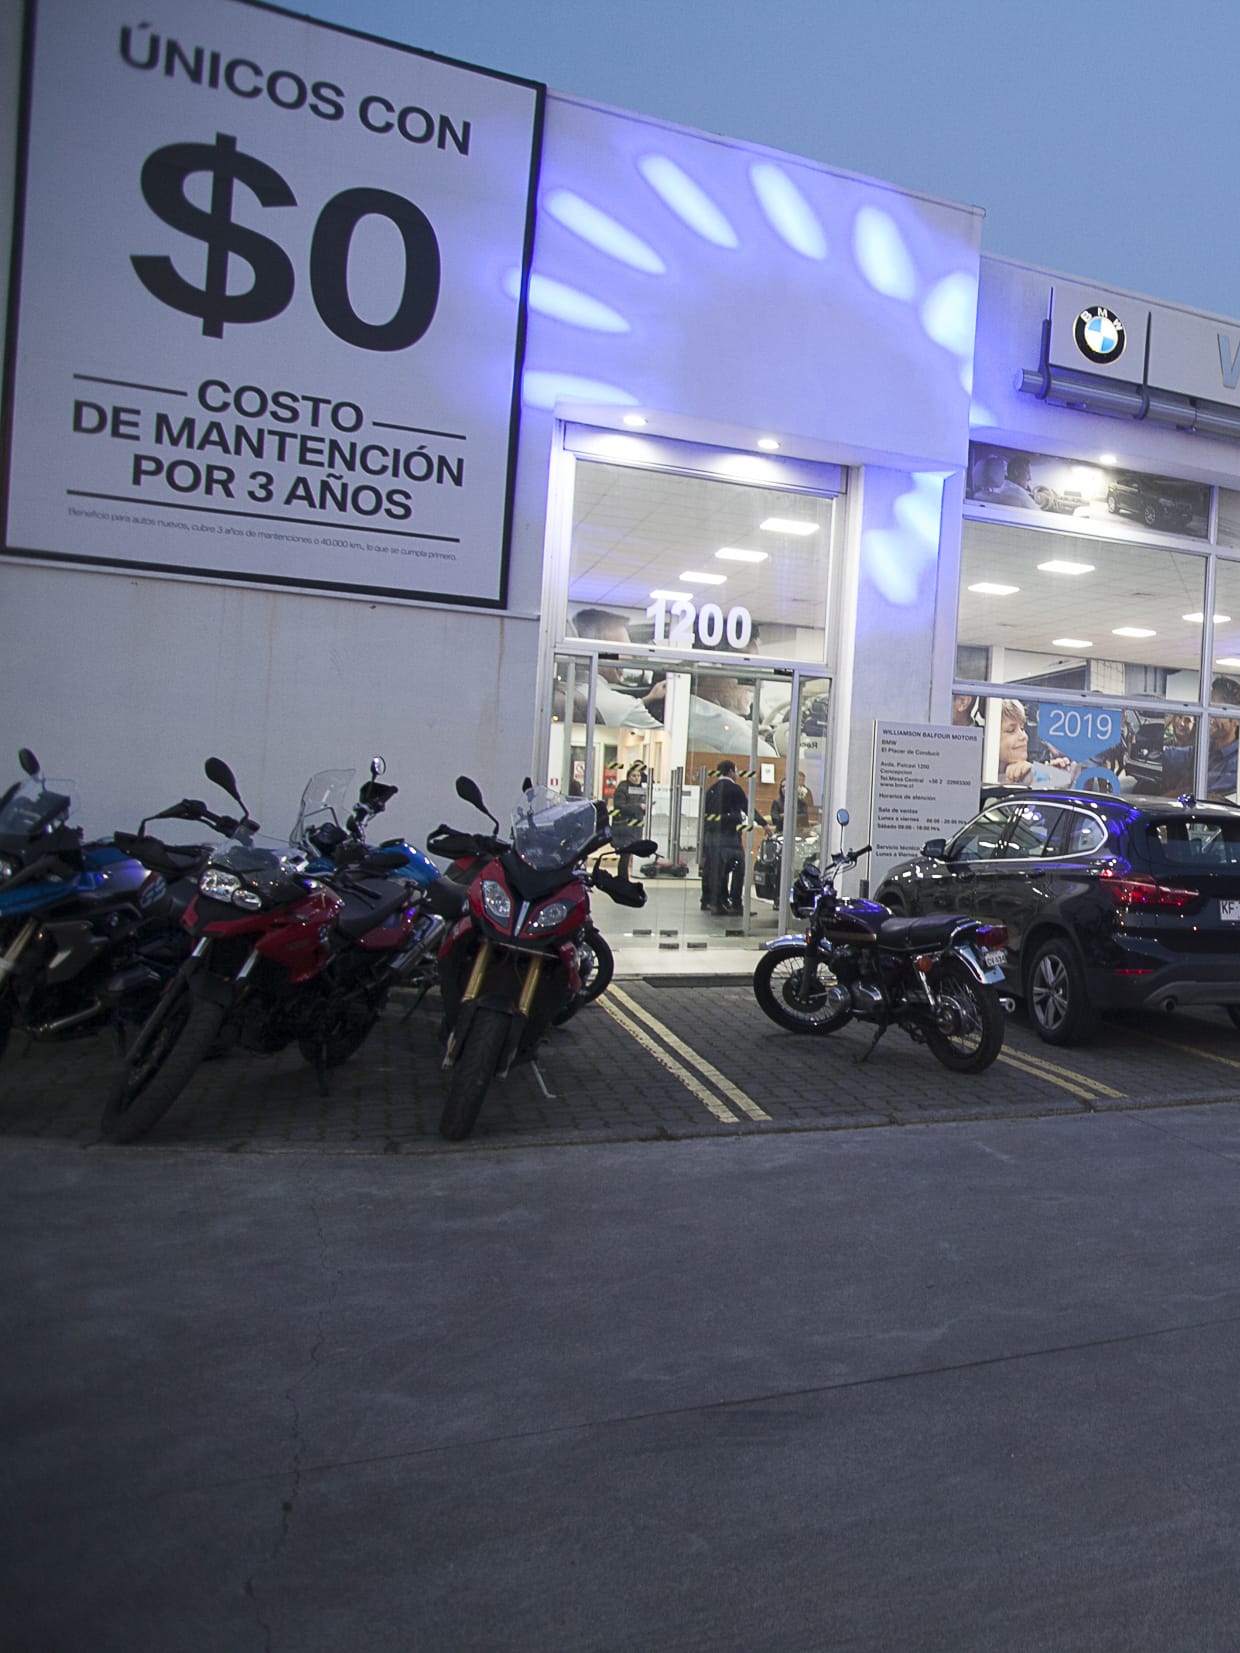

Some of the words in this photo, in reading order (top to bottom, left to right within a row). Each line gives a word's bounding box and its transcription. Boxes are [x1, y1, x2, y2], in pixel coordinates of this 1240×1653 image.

[119, 21, 345, 121] ÚNICOS
[358, 95, 471, 155] CON
[130, 132, 441, 352] $0
[197, 379, 364, 433] COSTO
[72, 400, 141, 441] DE
[154, 412, 464, 487] MANTENCIÓN
[132, 453, 236, 502] POR
[247, 471, 273, 503] 3
[283, 473, 413, 520] AÑOS
[68, 507, 110, 520] Beneficio
[111, 514, 131, 525] para
[132, 516, 156, 526] autos
[157, 519, 190, 531] nuevos,
[191, 522, 216, 533] cubre
[245, 529, 257, 538] de
[366, 542, 374, 551] lo
[375, 546, 389, 556] que
[646, 599, 752, 649] 1200
[883, 729, 921, 738] WILLIAMSON
[922, 732, 951, 740] BALFOUR
[951, 734, 978, 742] MOTORS
[1049, 710, 1112, 740] 2019
